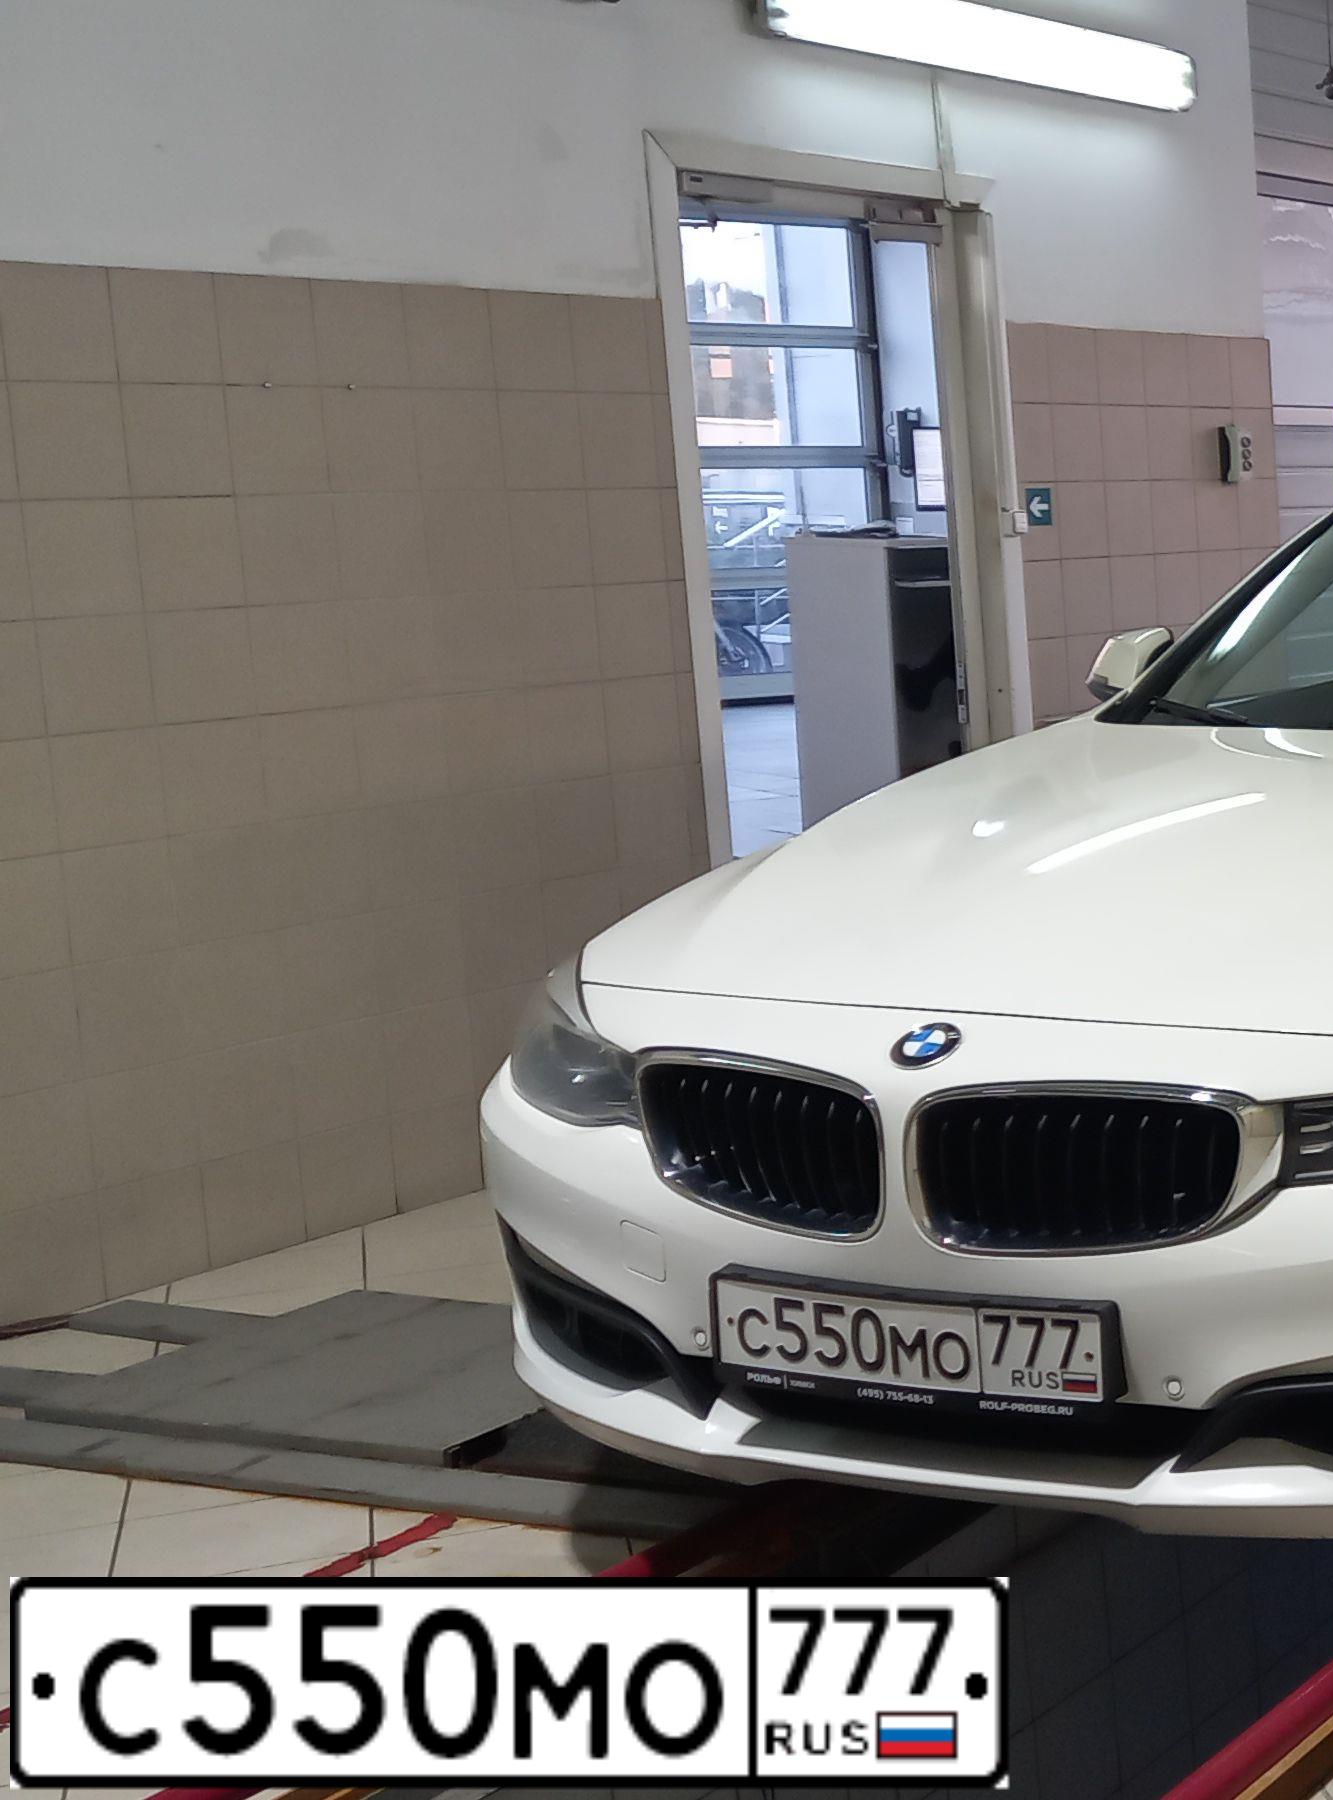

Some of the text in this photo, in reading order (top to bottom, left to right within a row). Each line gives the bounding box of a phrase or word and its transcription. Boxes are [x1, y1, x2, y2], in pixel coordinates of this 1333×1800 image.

[983, 1314, 1079, 1369] 777
[1012, 1369, 1059, 1390] RUS
[979, 1400, 1074, 1416] ROLF-PROBEG.RU
